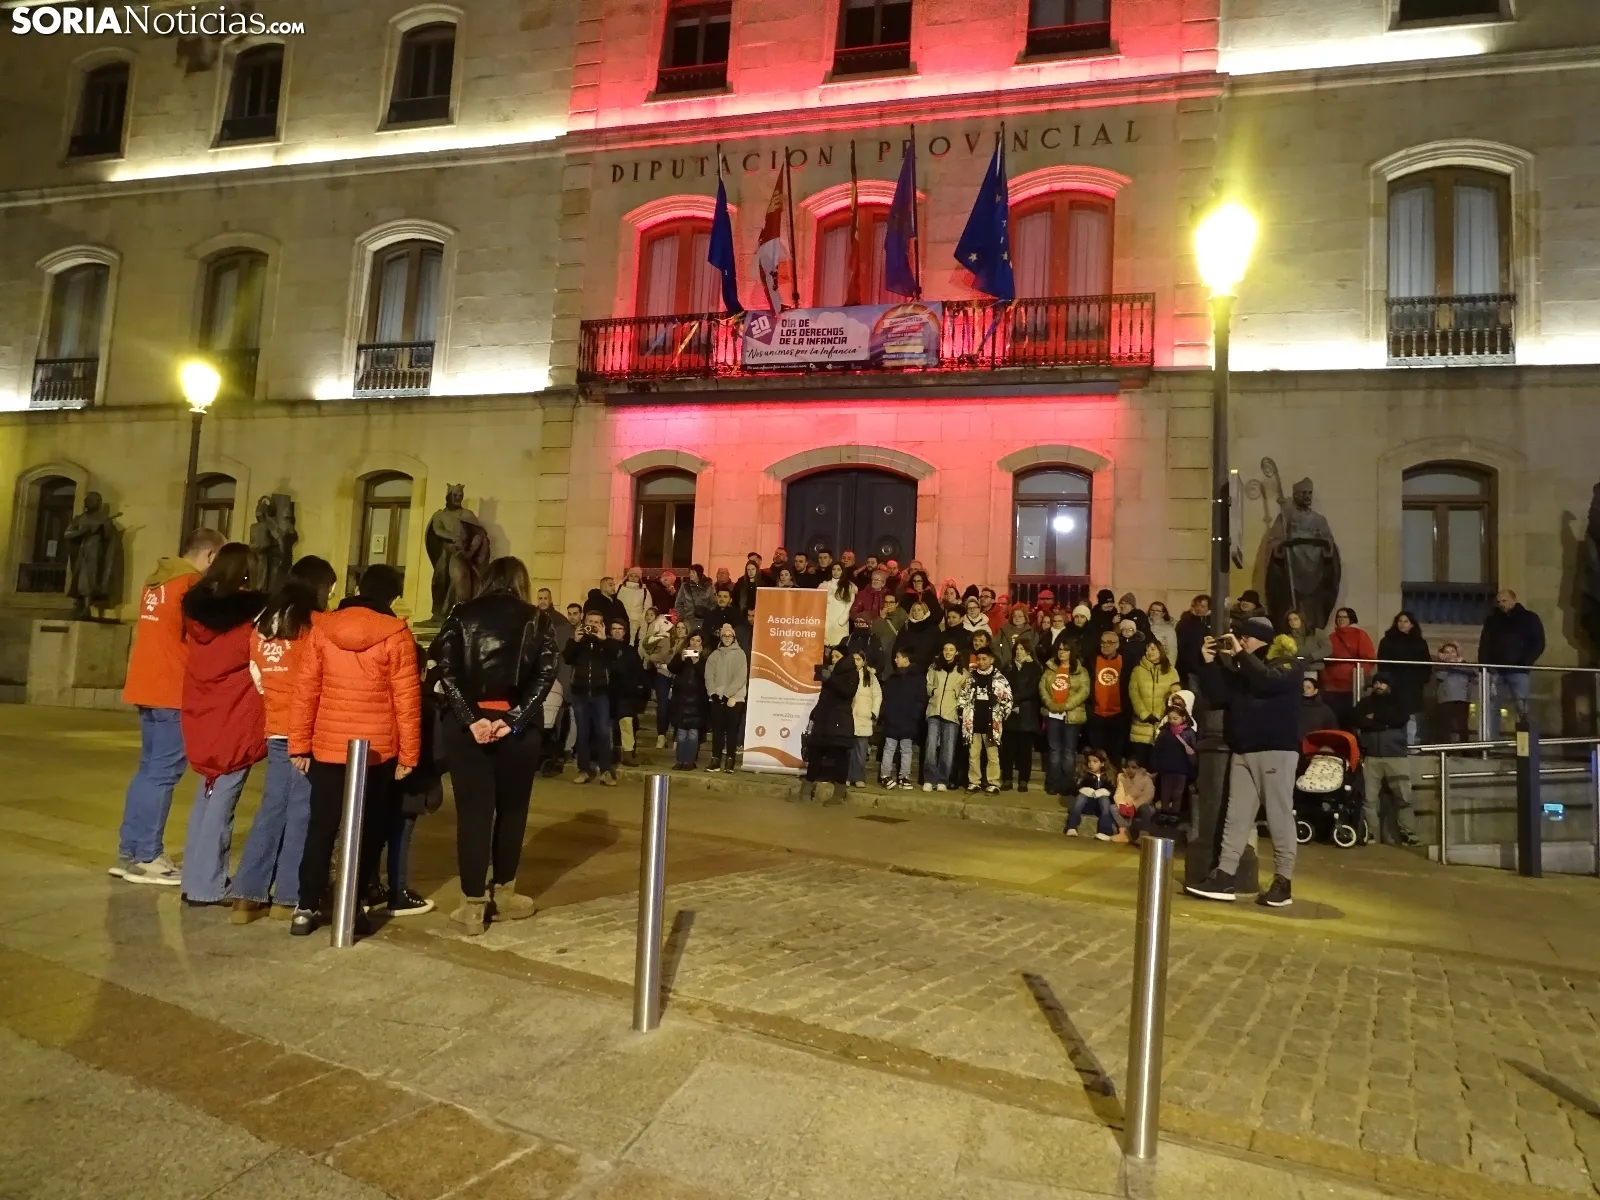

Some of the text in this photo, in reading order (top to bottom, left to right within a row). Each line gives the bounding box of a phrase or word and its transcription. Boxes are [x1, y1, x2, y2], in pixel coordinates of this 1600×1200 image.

[750, 315, 771, 333] 20
[798, 318, 810, 328] DE
[780, 328, 797, 337] LOS
[799, 327, 844, 337] DERECHOS
[779, 336, 848, 345] DE LA INFANCIA
[764, 348, 795, 357] unimos
[795, 349, 808, 358] por
[767, 614, 821, 625] Asociación
[769, 627, 817, 638] Síndrome
